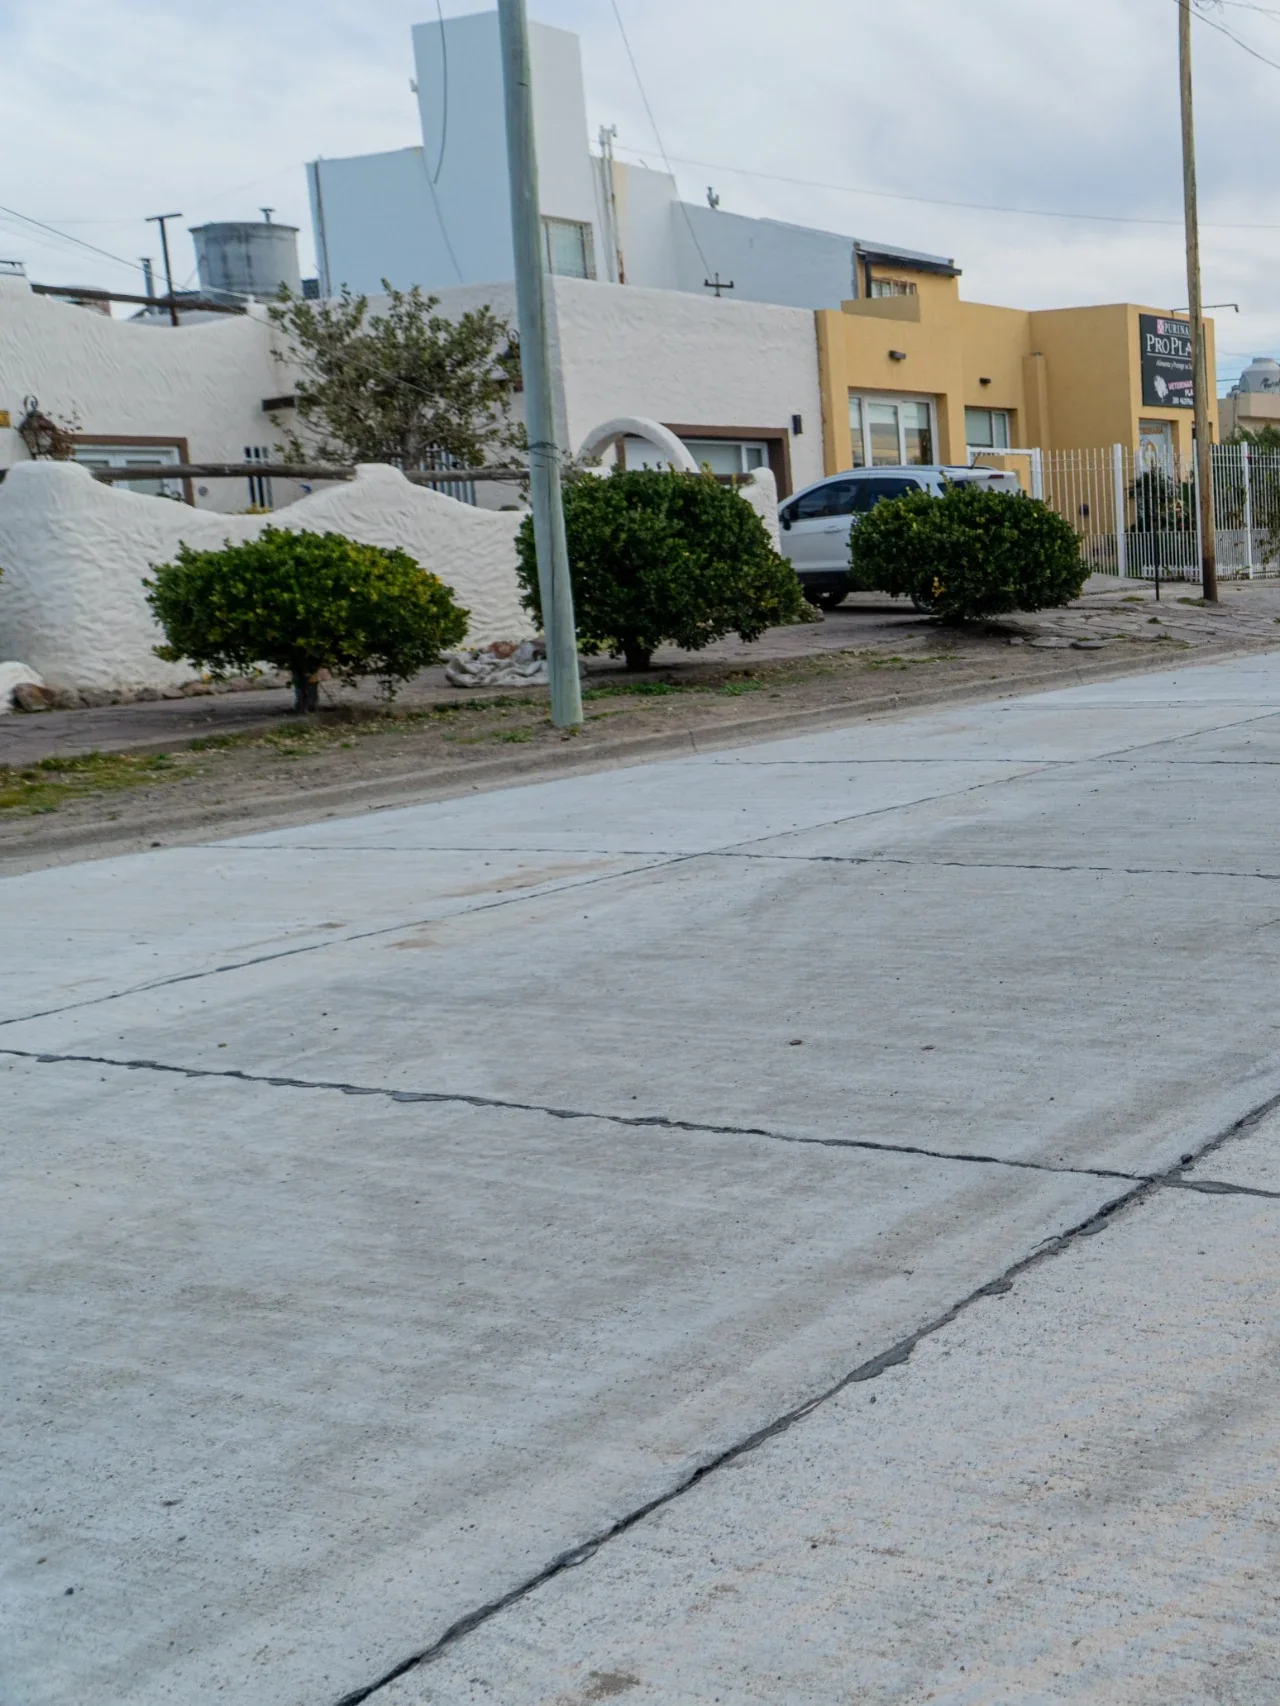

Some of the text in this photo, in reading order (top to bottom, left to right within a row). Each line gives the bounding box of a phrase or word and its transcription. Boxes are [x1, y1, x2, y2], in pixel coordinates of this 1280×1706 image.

[1164, 322, 1189, 335] PURINA
[1146, 334, 1192, 356] PRO PLA
[1168, 380, 1193, 390] VETERINAR
